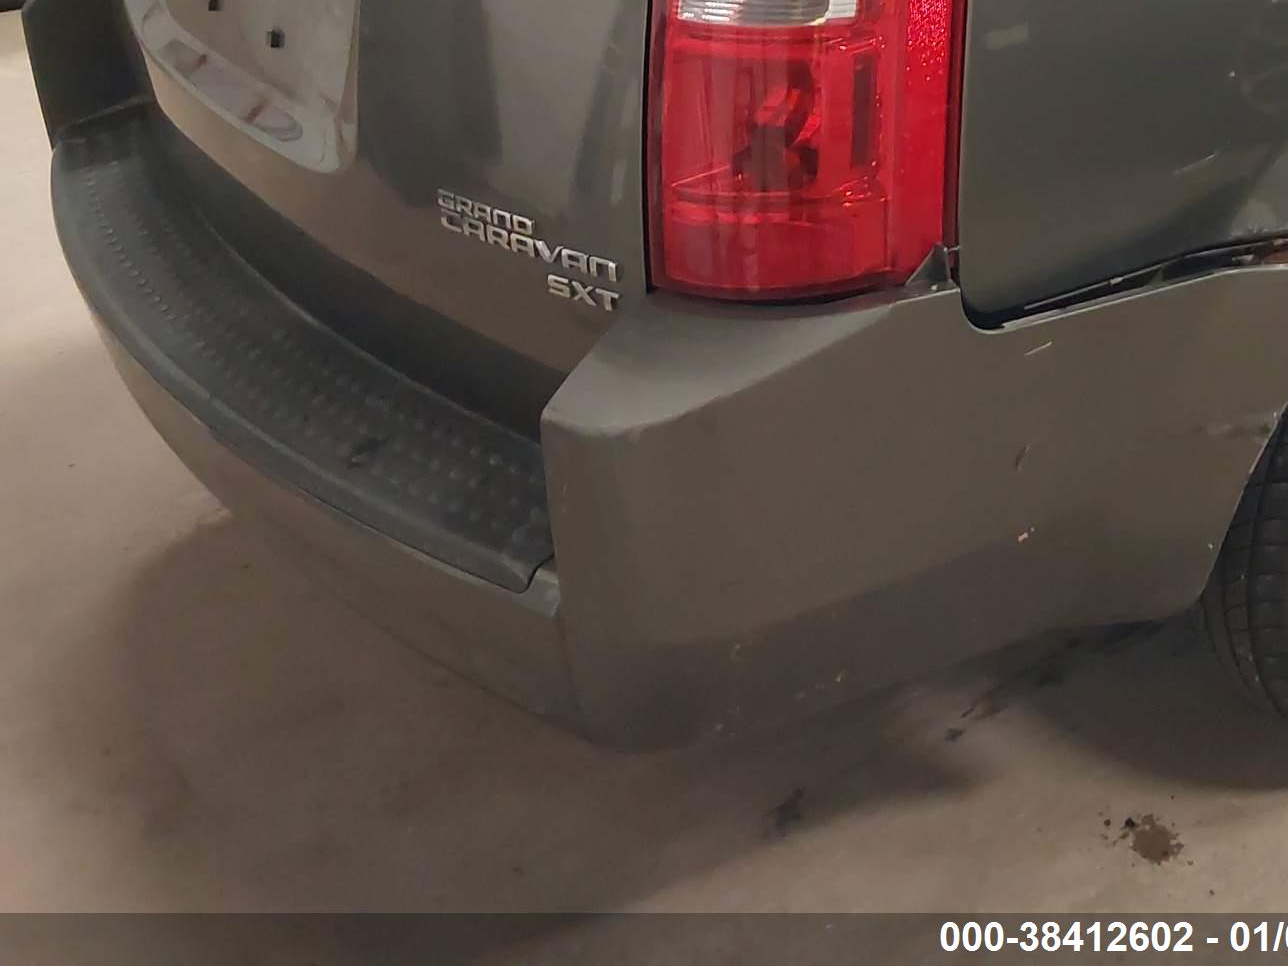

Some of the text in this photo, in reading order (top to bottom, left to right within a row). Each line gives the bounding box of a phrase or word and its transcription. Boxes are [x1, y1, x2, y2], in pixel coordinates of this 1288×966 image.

[437, 188, 536, 236] GRAND
[439, 208, 619, 283] CARAVAN
[547, 273, 621, 312] SXT
